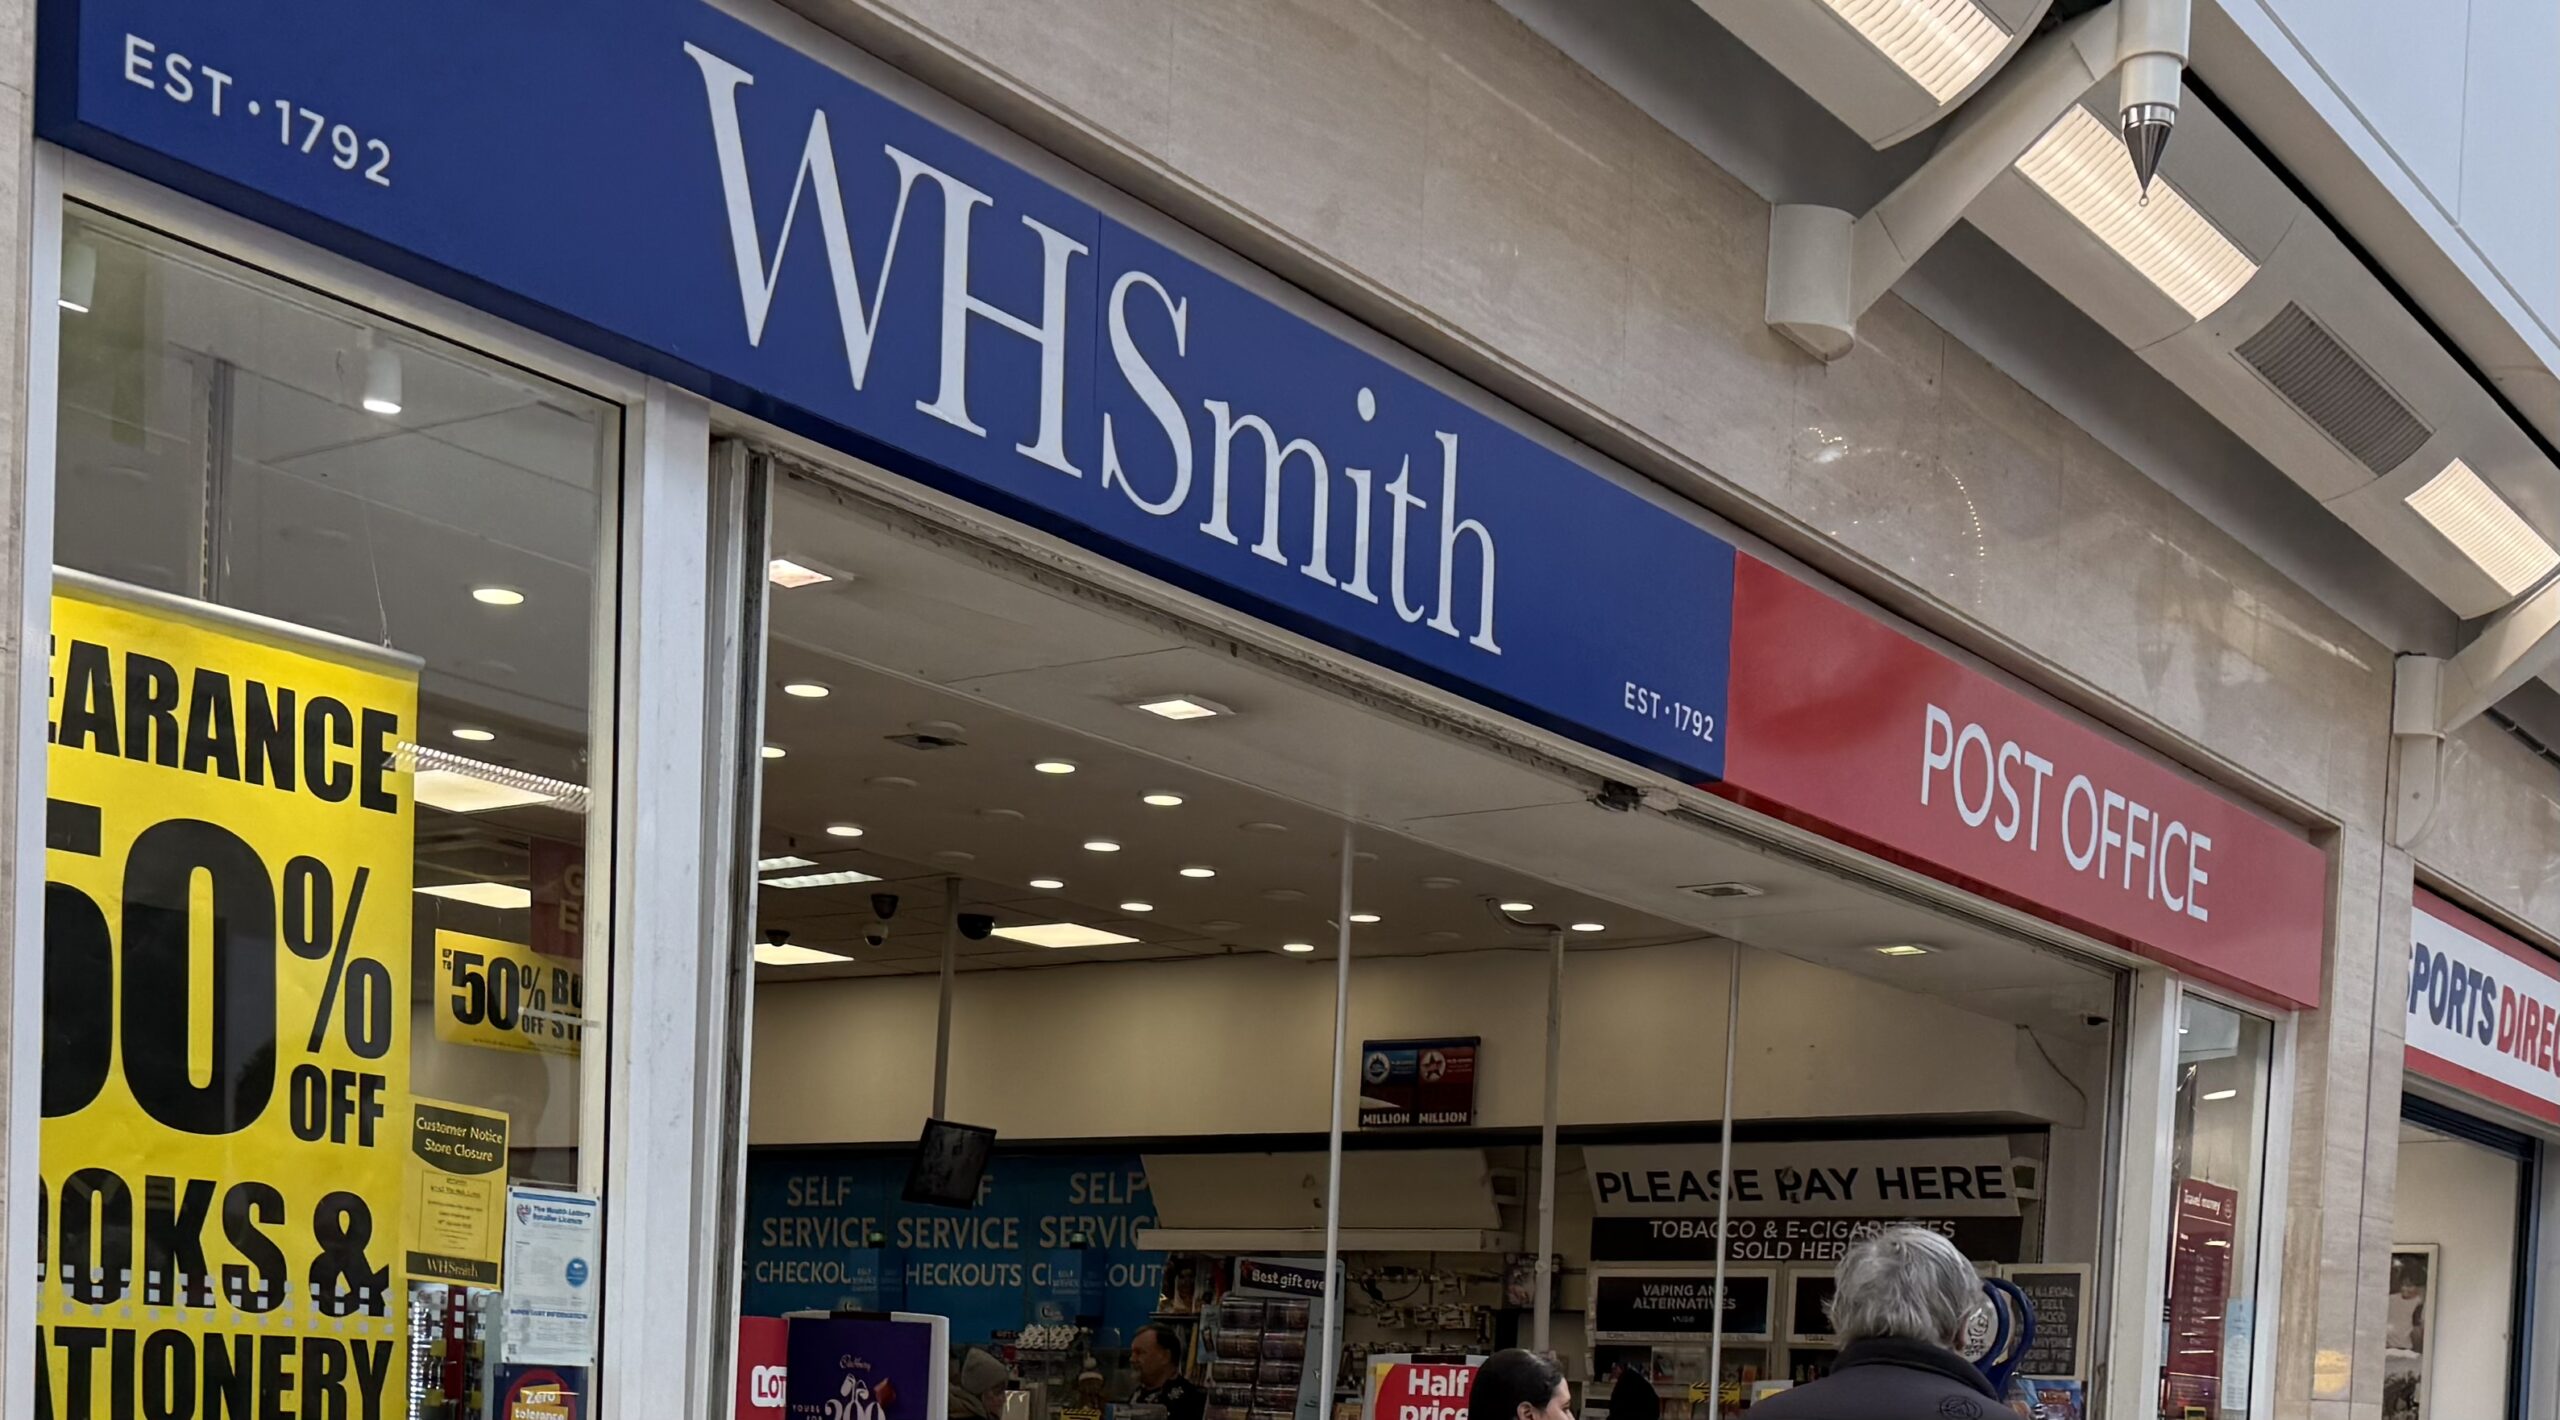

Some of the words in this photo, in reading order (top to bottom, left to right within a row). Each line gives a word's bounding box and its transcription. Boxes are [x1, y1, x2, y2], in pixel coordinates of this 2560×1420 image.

[683, 40, 1502, 656] WHSmith
[49, 635, 398, 814] ARANCE
[1921, 703, 2053, 851] POST
[2061, 775, 2211, 922] OFFICE
[451, 950, 546, 1030] 50%
[522, 1014, 545, 1034] OFF
[289, 1063, 386, 1147] OFF
[1363, 1113, 1410, 1124] MILLION
[1419, 1112, 1467, 1123] MILLION
[416, 1117, 467, 1137] Customer
[470, 1127, 503, 1144] Notice
[424, 1138, 452, 1155] Store
[454, 1143, 493, 1161] Closure
[787, 1176, 853, 1206] SELF
[1597, 1170, 1763, 1203] PLEASE
[1777, 1168, 1858, 1203] PAY
[1876, 1165, 2006, 1199] HERE
[38, 1168, 288, 1313] OKS
[309, 1191, 389, 1317] &
[762, 1217, 876, 1248] SERVICE
[897, 1217, 1020, 1249] SERVICE
[1039, 1215, 1160, 1248] SERVIC
[1649, 1220, 1756, 1239] TOBACCO
[1763, 1220, 1777, 1238] &
[1732, 1241, 1792, 1259] SOLD
[1800, 1241, 1848, 1260] HER
[427, 1258, 478, 1277] WHSmith
[1252, 1269, 1278, 1284] Best
[1280, 1274, 1303, 1288] gift
[1633, 1297, 1736, 1310] ALTERNATIVES
[1643, 1284, 1693, 1296] VAPING
[1698, 1284, 1728, 1296] AND
[1408, 1368, 1470, 1396] Half
[526, 1392, 556, 1403] Zero
[515, 1409, 564, 1420] tolerance
